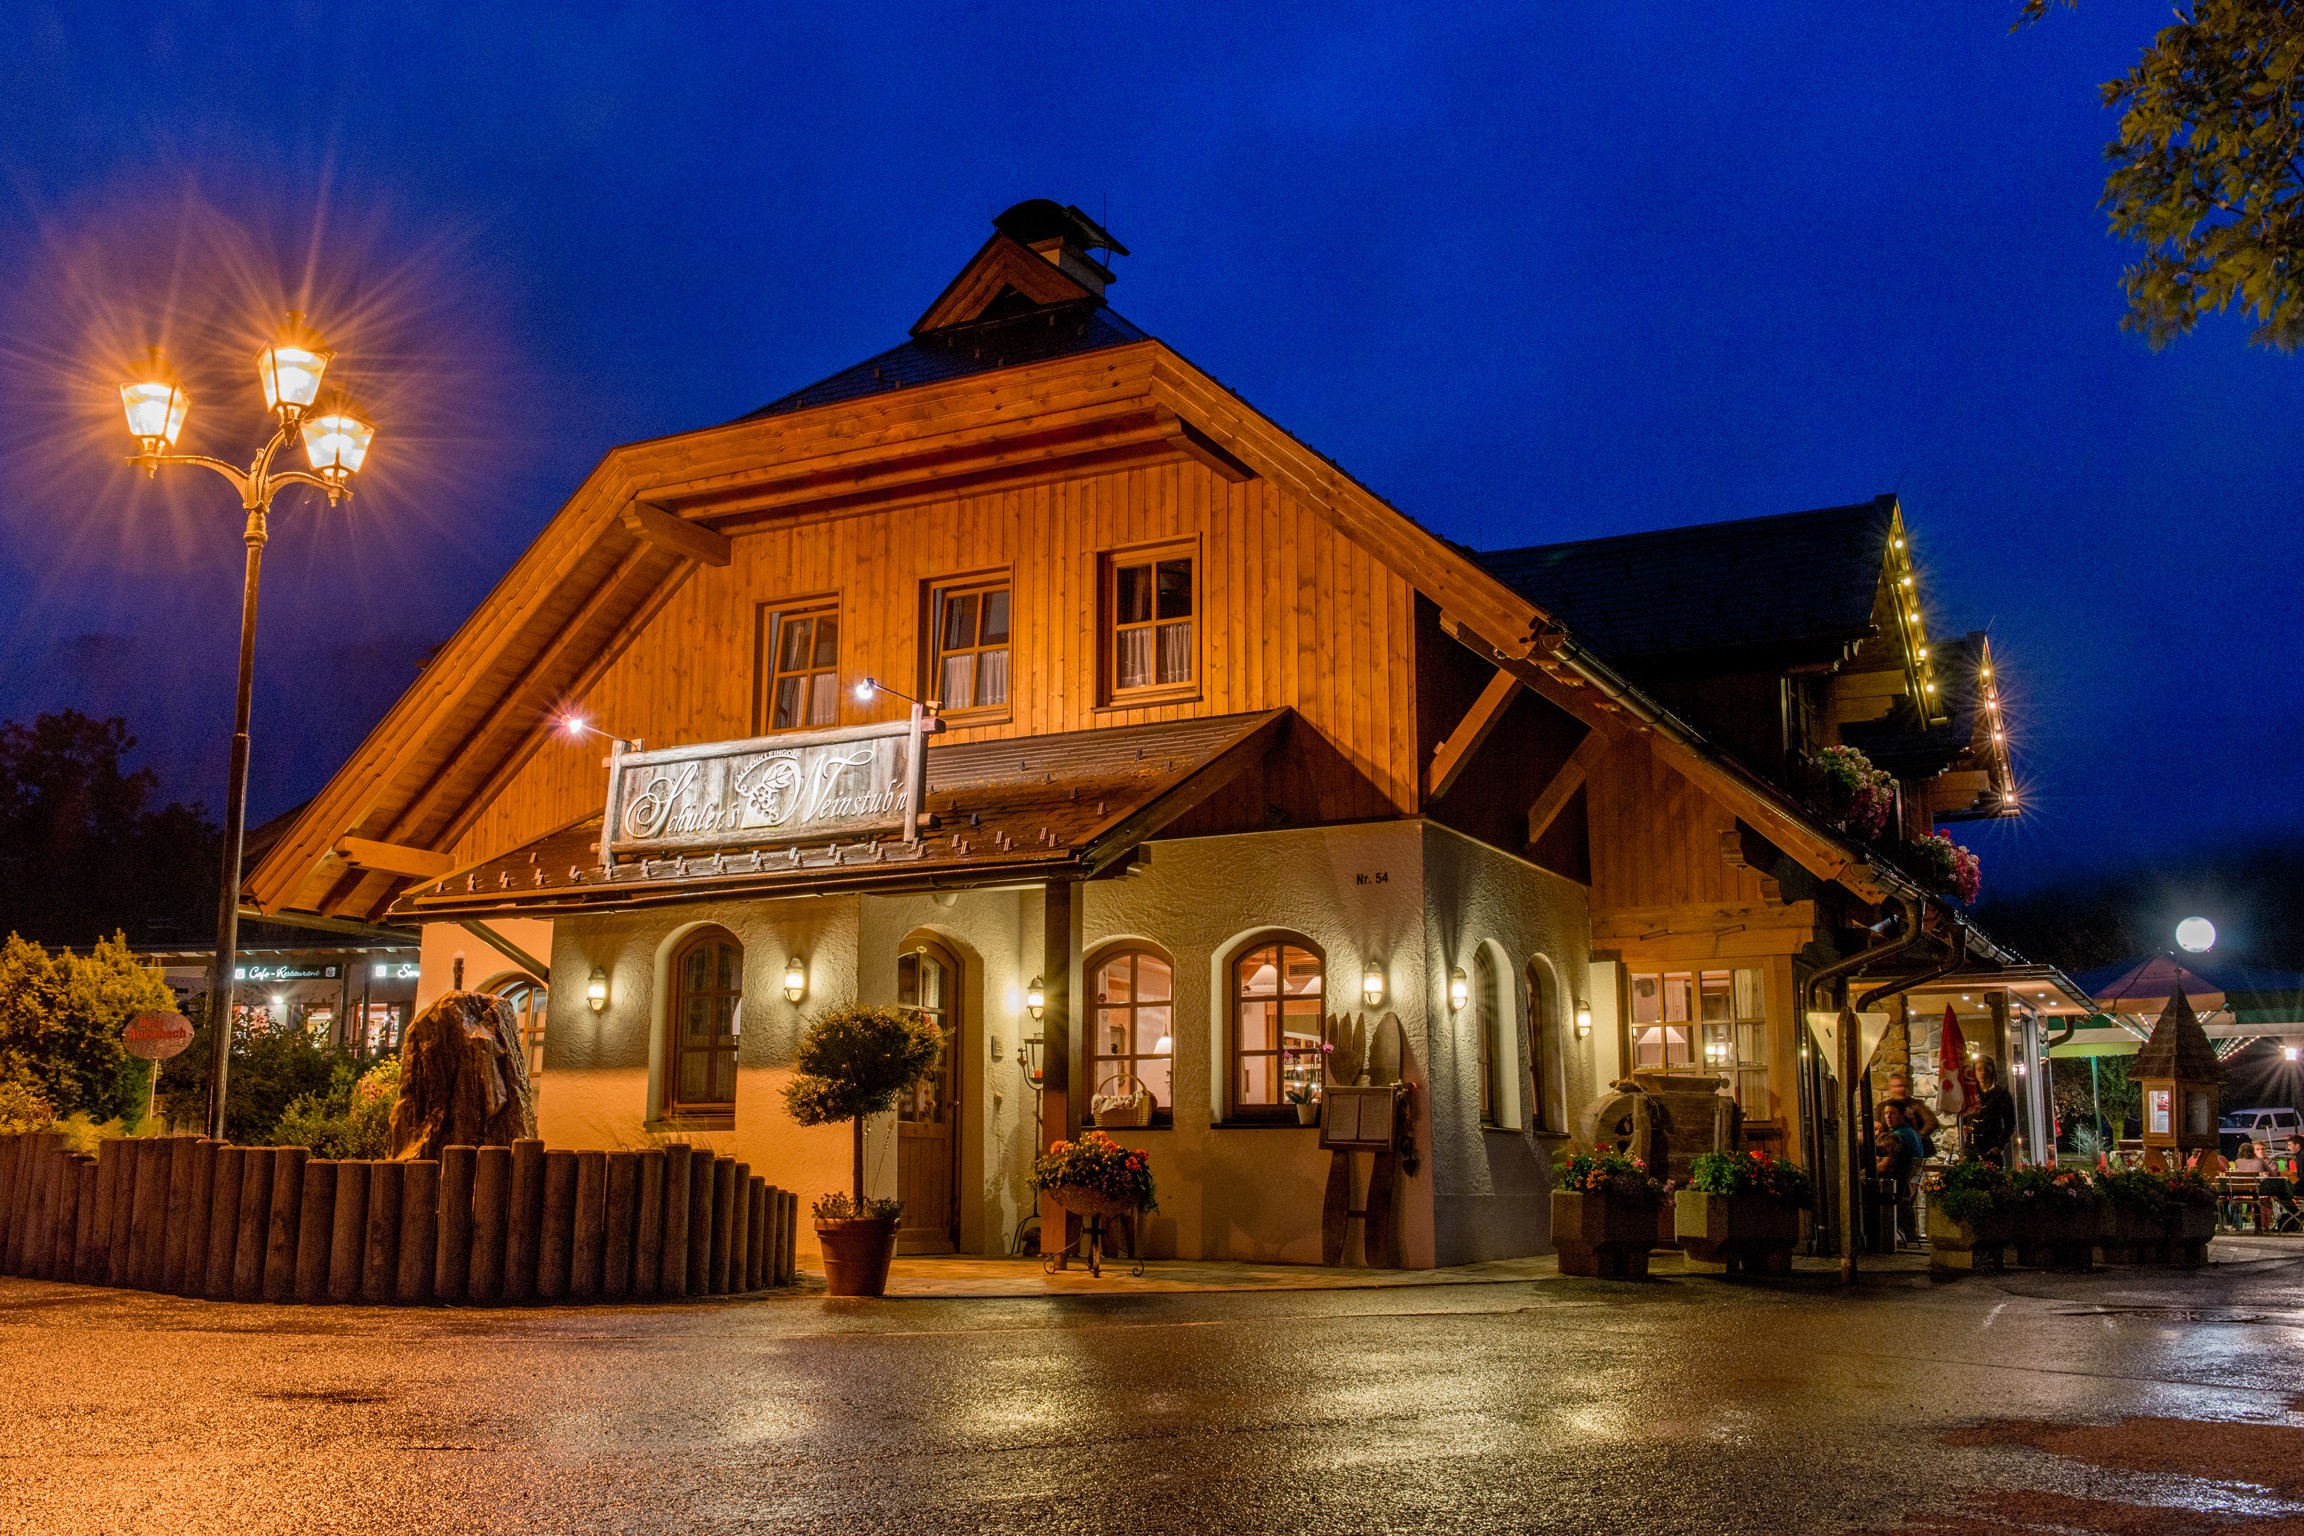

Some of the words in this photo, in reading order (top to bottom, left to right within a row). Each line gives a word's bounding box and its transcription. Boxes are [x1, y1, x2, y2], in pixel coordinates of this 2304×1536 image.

[736, 749, 802, 783] ALPENKLEINGOLF
[1356, 873, 1371, 885] Nr.
[1375, 872, 1388, 884] 54
